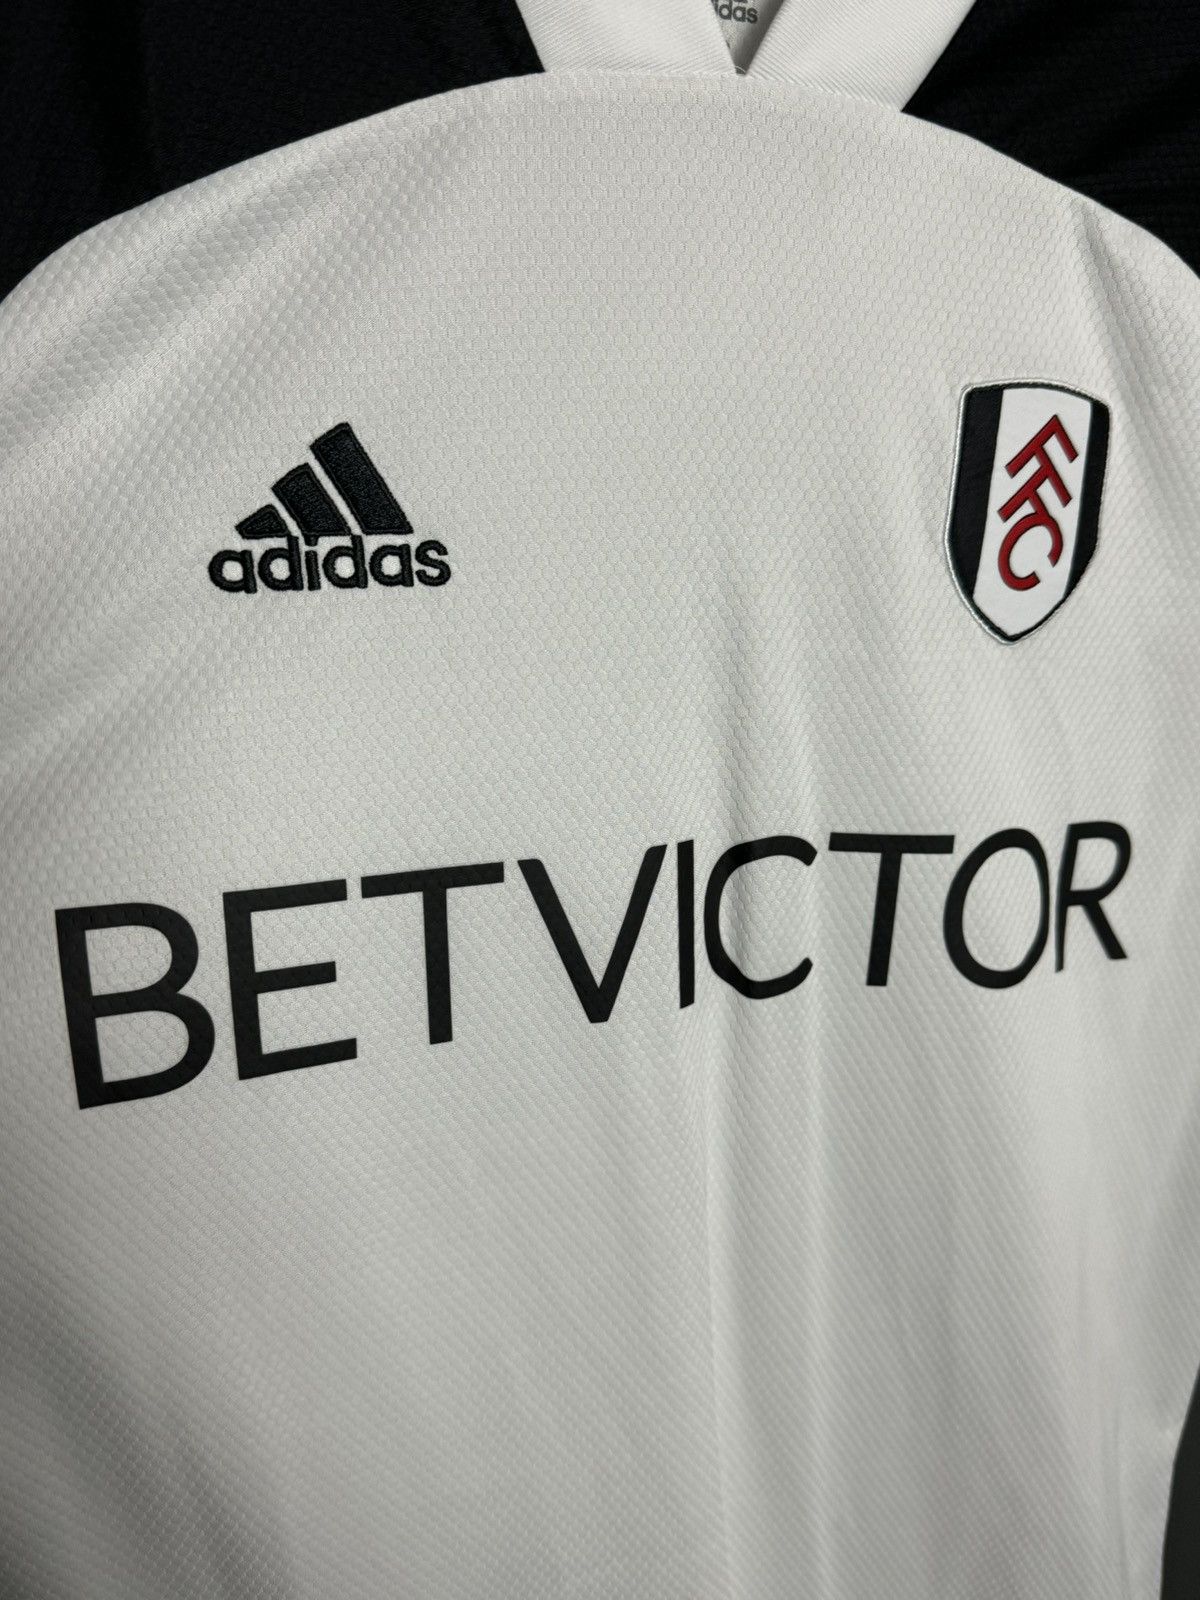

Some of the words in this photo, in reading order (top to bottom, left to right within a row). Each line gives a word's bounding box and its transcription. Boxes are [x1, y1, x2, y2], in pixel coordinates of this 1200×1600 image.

[208, 535, 451, 594] adidas
[997, 414, 1079, 591] FFC
[55, 821, 1131, 1110] BETVICTOR
